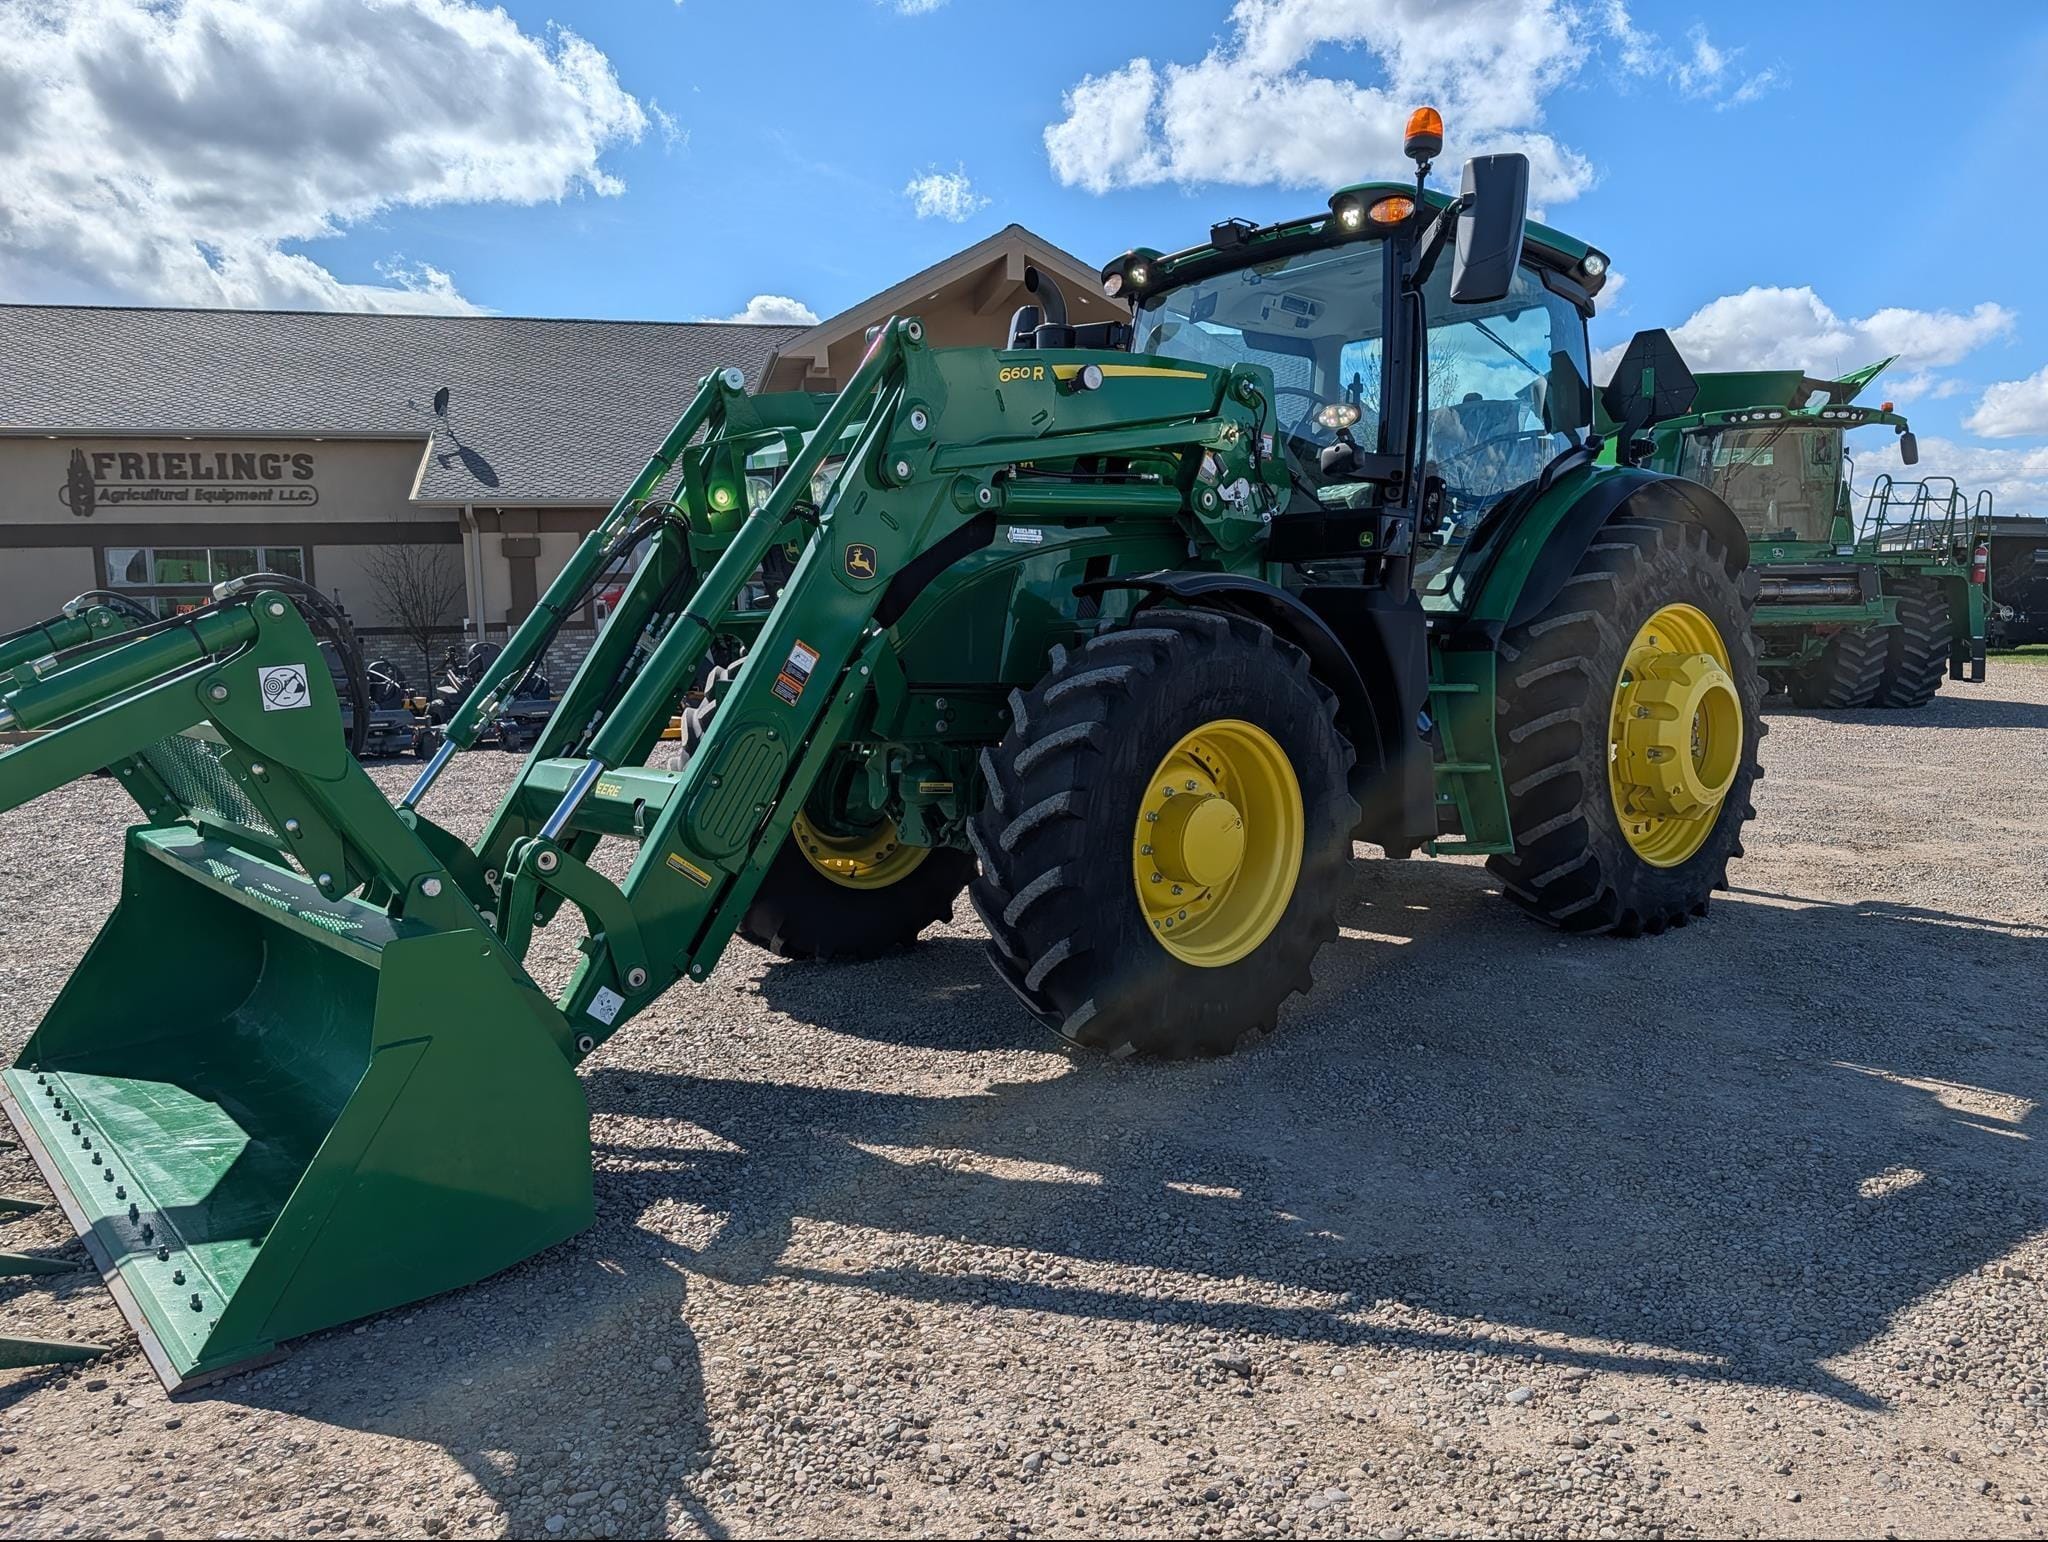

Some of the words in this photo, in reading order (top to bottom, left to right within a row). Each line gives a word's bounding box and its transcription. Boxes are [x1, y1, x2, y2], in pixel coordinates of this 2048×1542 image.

[91, 452, 314, 480] FRIELING'S
[98, 488, 189, 503] Agricultural
[195, 488, 273, 503] Equipment
